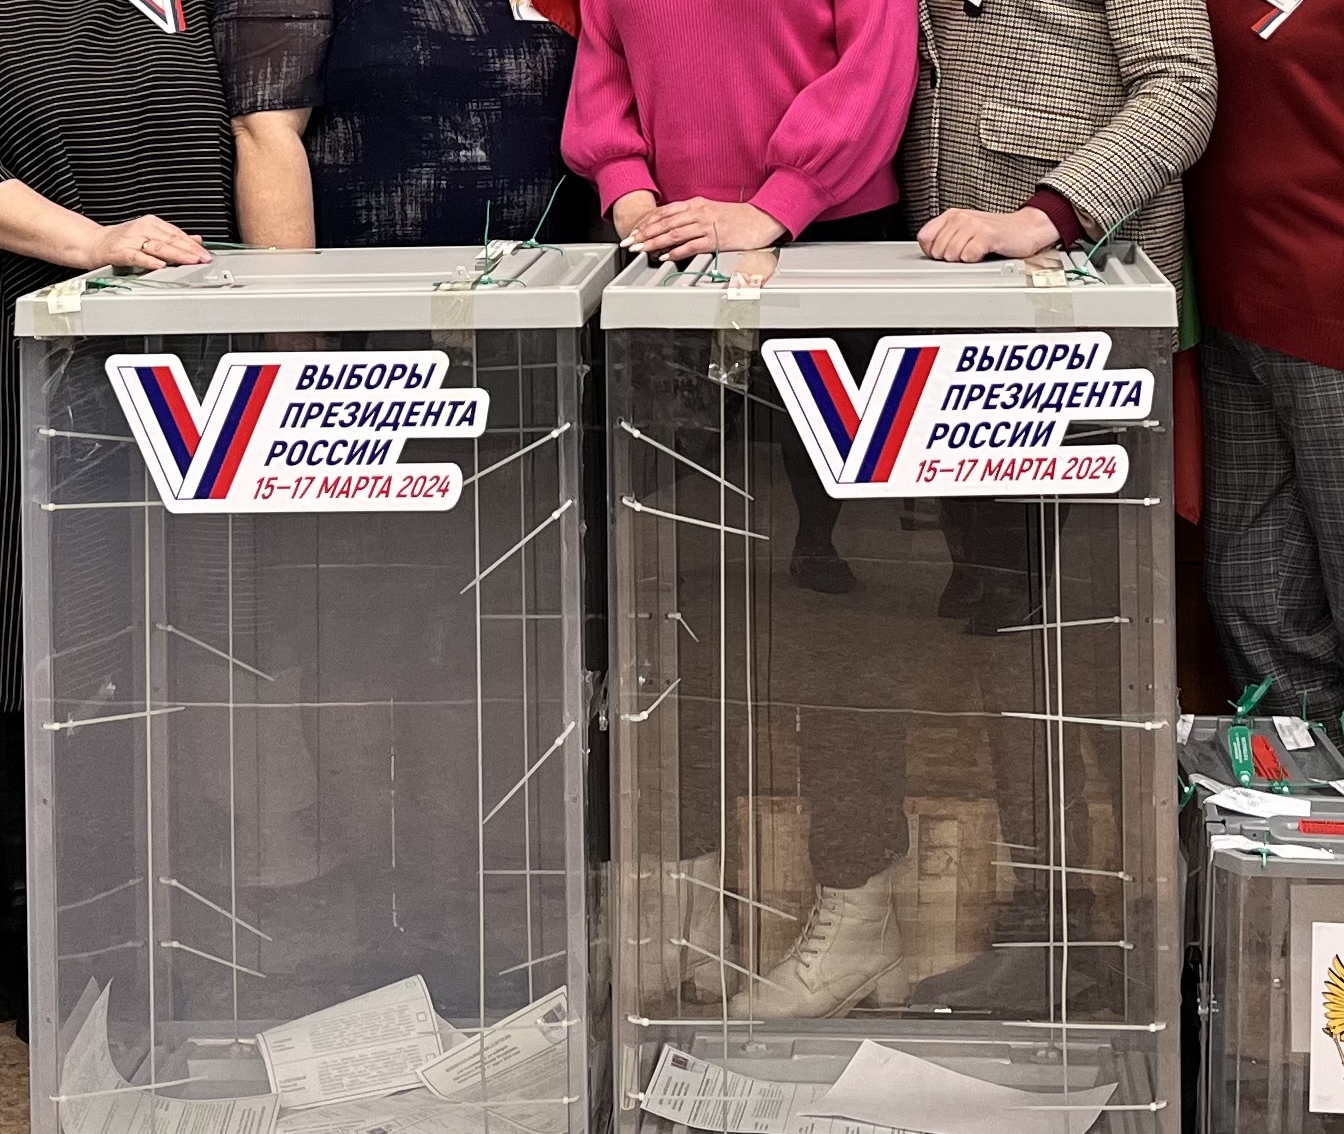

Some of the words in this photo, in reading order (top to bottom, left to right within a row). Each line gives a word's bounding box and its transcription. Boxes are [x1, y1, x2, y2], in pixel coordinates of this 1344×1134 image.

[956, 343, 1099, 372] ВЫБОРЫ
[295, 363, 437, 390] ВЫБОРЫ
[940, 380, 1143, 413] ПРЕЗИДЕНТА
[280, 400, 478, 432] ПРЕЗИДЕНТА
[926, 420, 1056, 450] РОССИИ
[264, 439, 392, 466] РОССИИ
[980, 457, 1057, 482] МАРТА
[1062, 456, 1117, 480] 2024
[316, 475, 392, 498] МАРТА
[396, 474, 451, 498] 2024
